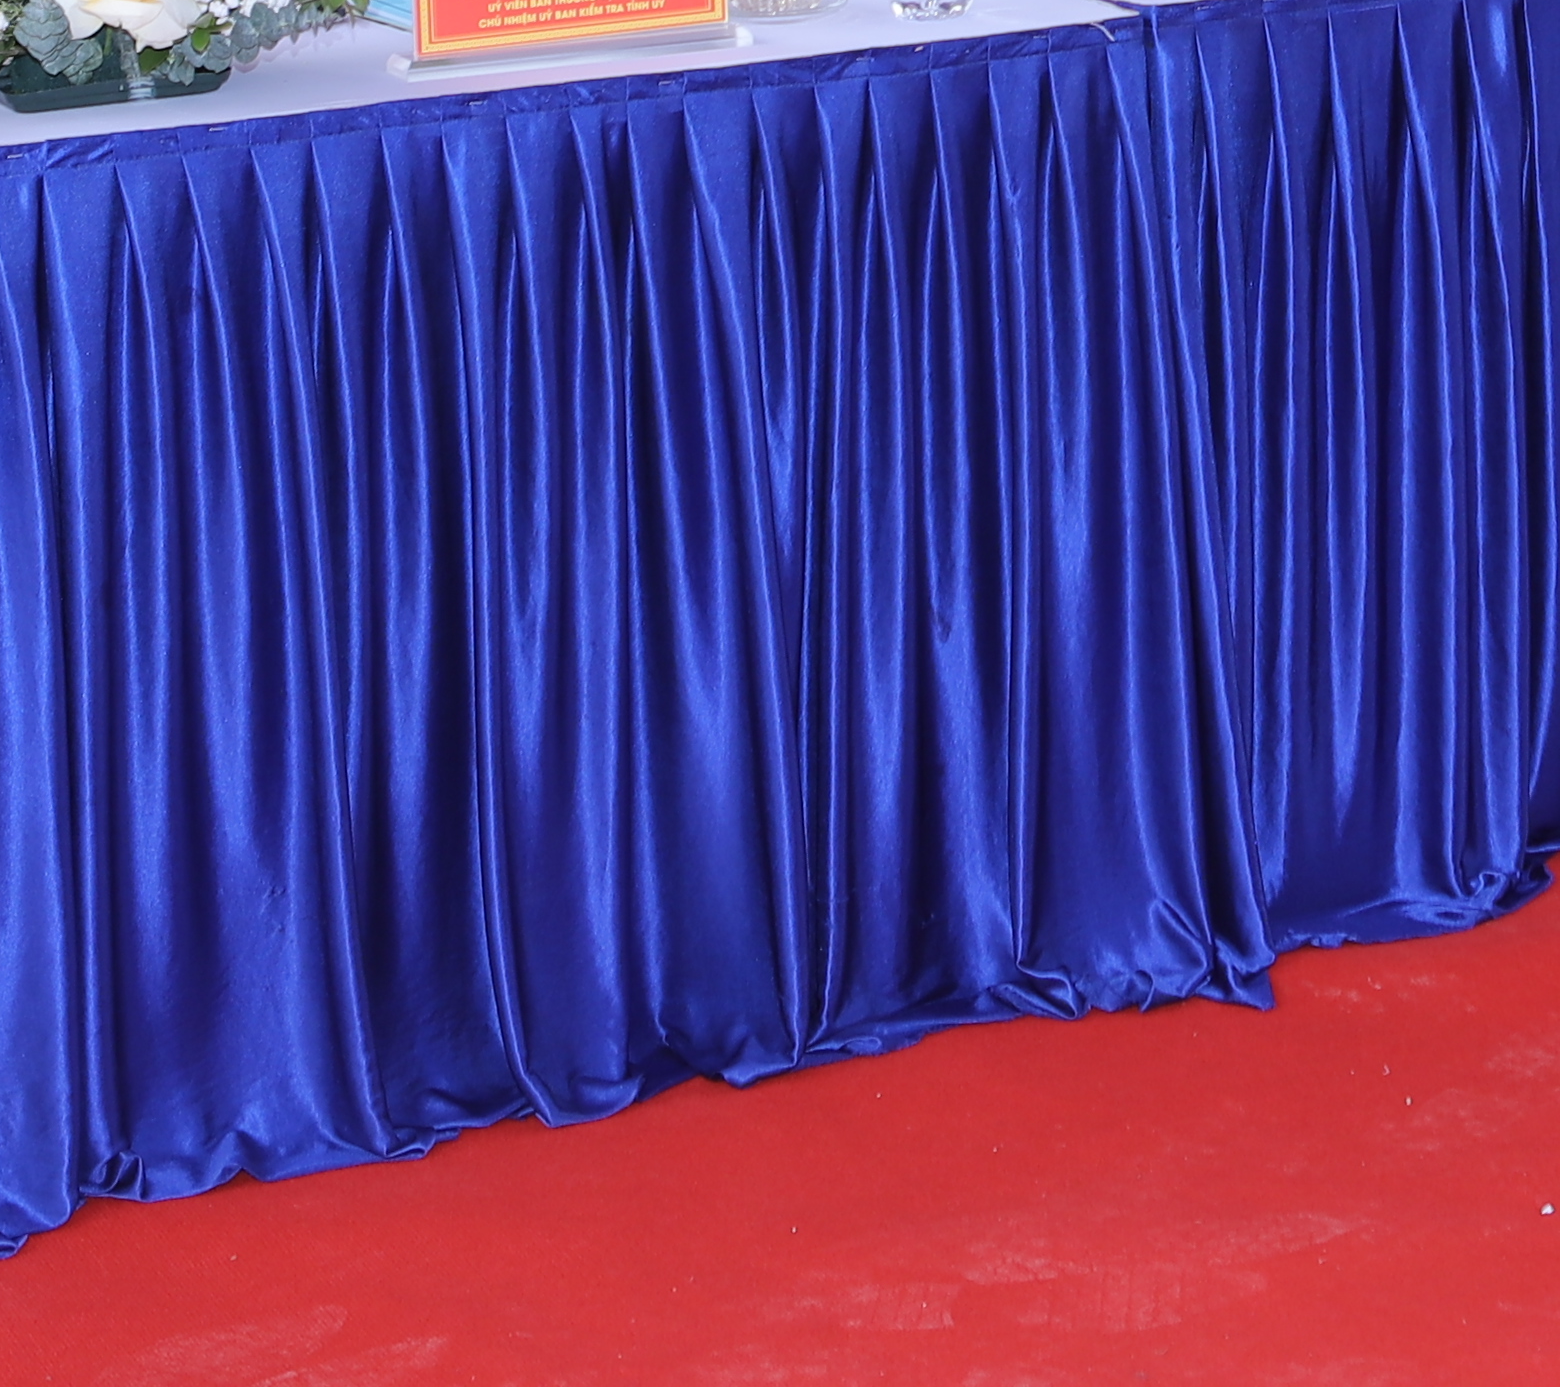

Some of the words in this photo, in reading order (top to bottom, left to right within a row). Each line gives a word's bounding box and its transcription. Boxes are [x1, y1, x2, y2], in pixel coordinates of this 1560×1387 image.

[478, 14, 501, 29] CHỦ
[504, 11, 537, 28] NHIỆM
[555, 7, 577, 20] BAN
[579, 2, 604, 19] KIỂM
[606, 1, 625, 14] TRA
